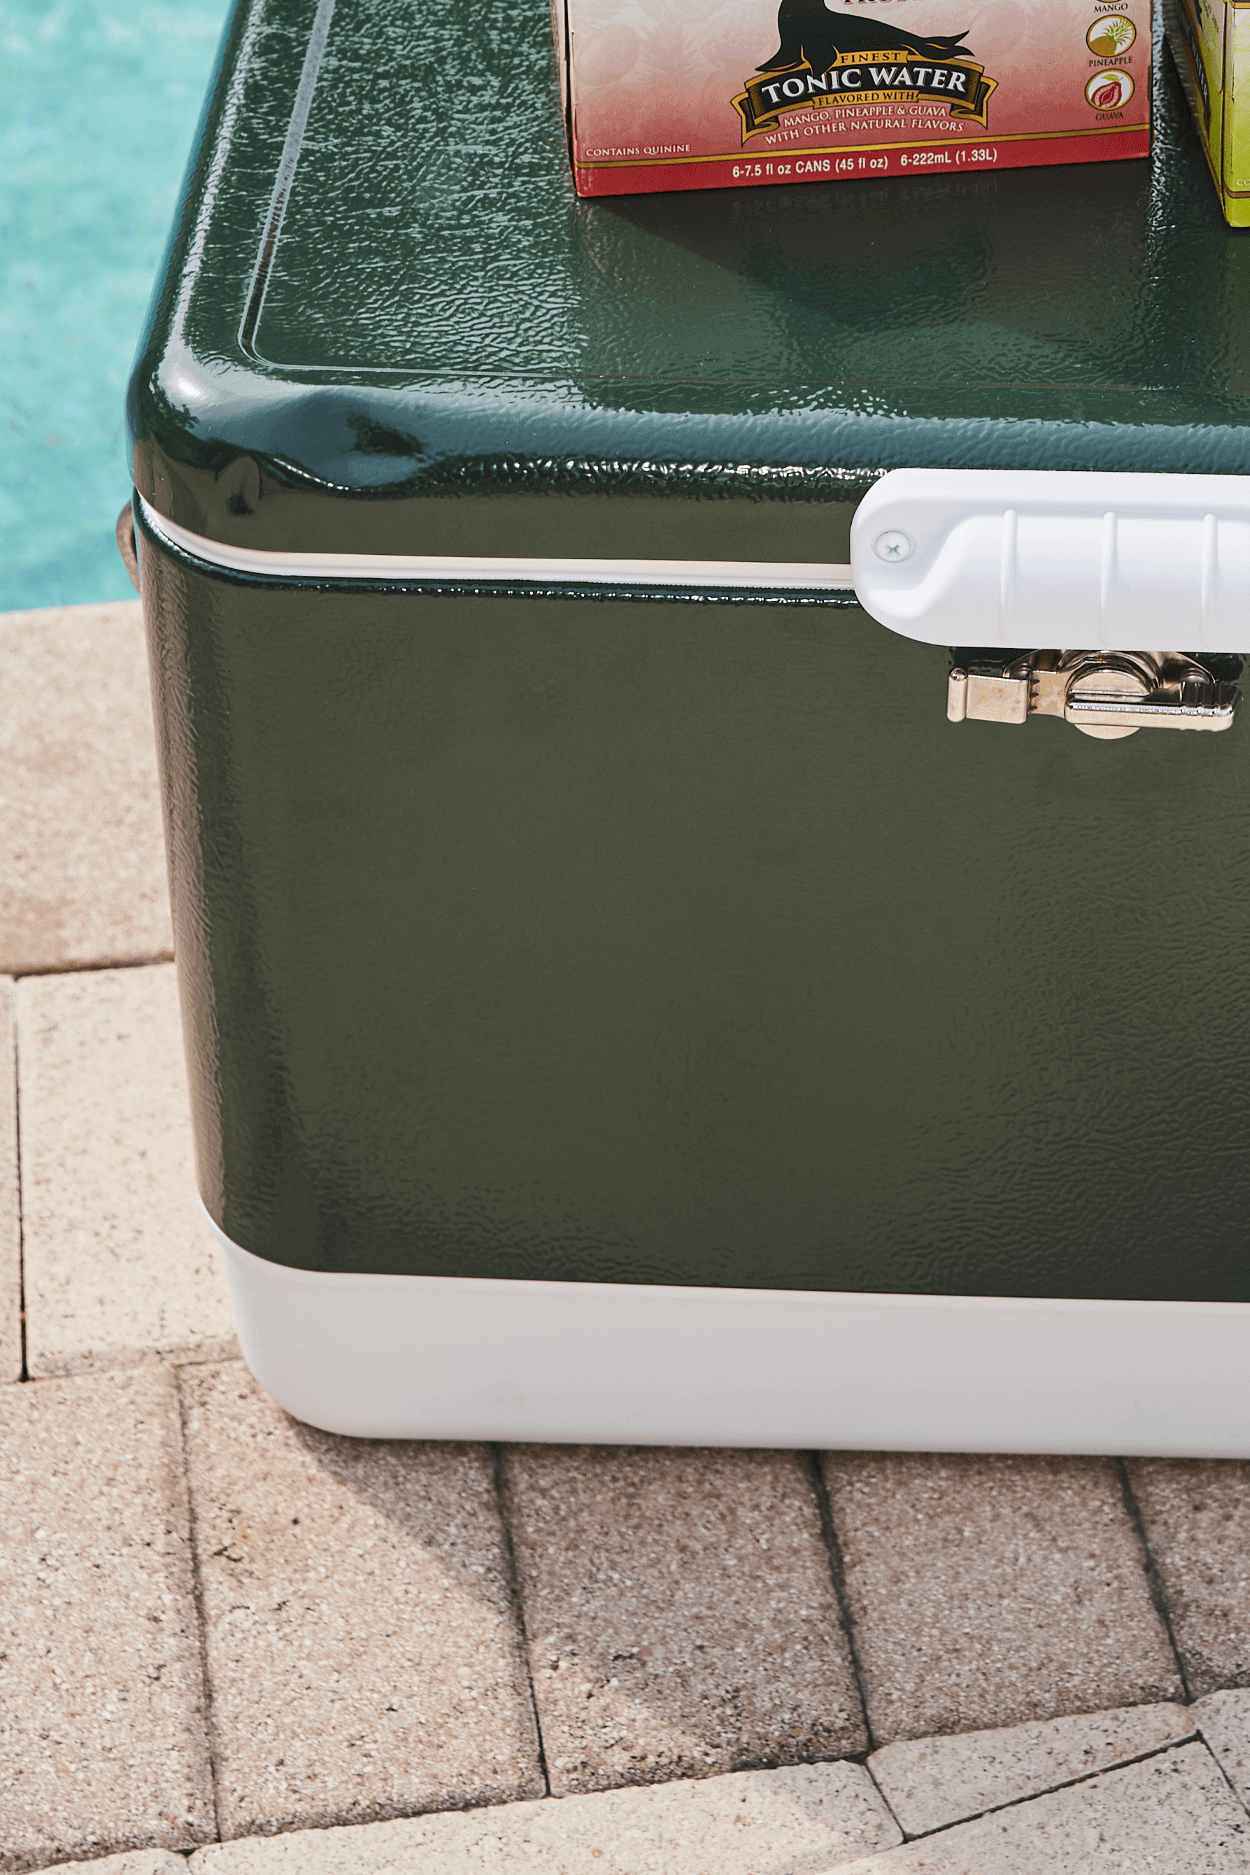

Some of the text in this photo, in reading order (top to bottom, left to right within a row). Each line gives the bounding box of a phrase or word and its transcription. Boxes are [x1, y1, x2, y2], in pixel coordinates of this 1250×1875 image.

[1094, 3, 1128, 12] MANGO
[841, 53, 900, 64] FINEST
[1089, 57, 1132, 67] PINEAPPLE
[761, 67, 966, 104] TONIC WATER
[818, 92, 915, 106] FLAVORED WITH
[784, 106, 946, 127] MANGO, PINEAPPLE GUAVA
[1096, 111, 1123, 121] GUAVA
[765, 119, 963, 144] WITH OTHER NATURAL FLAVORS
[732, 148, 997, 177] 6-7.5 fl oz CANS (45 fl oz) 6-222mL (1.33L)
